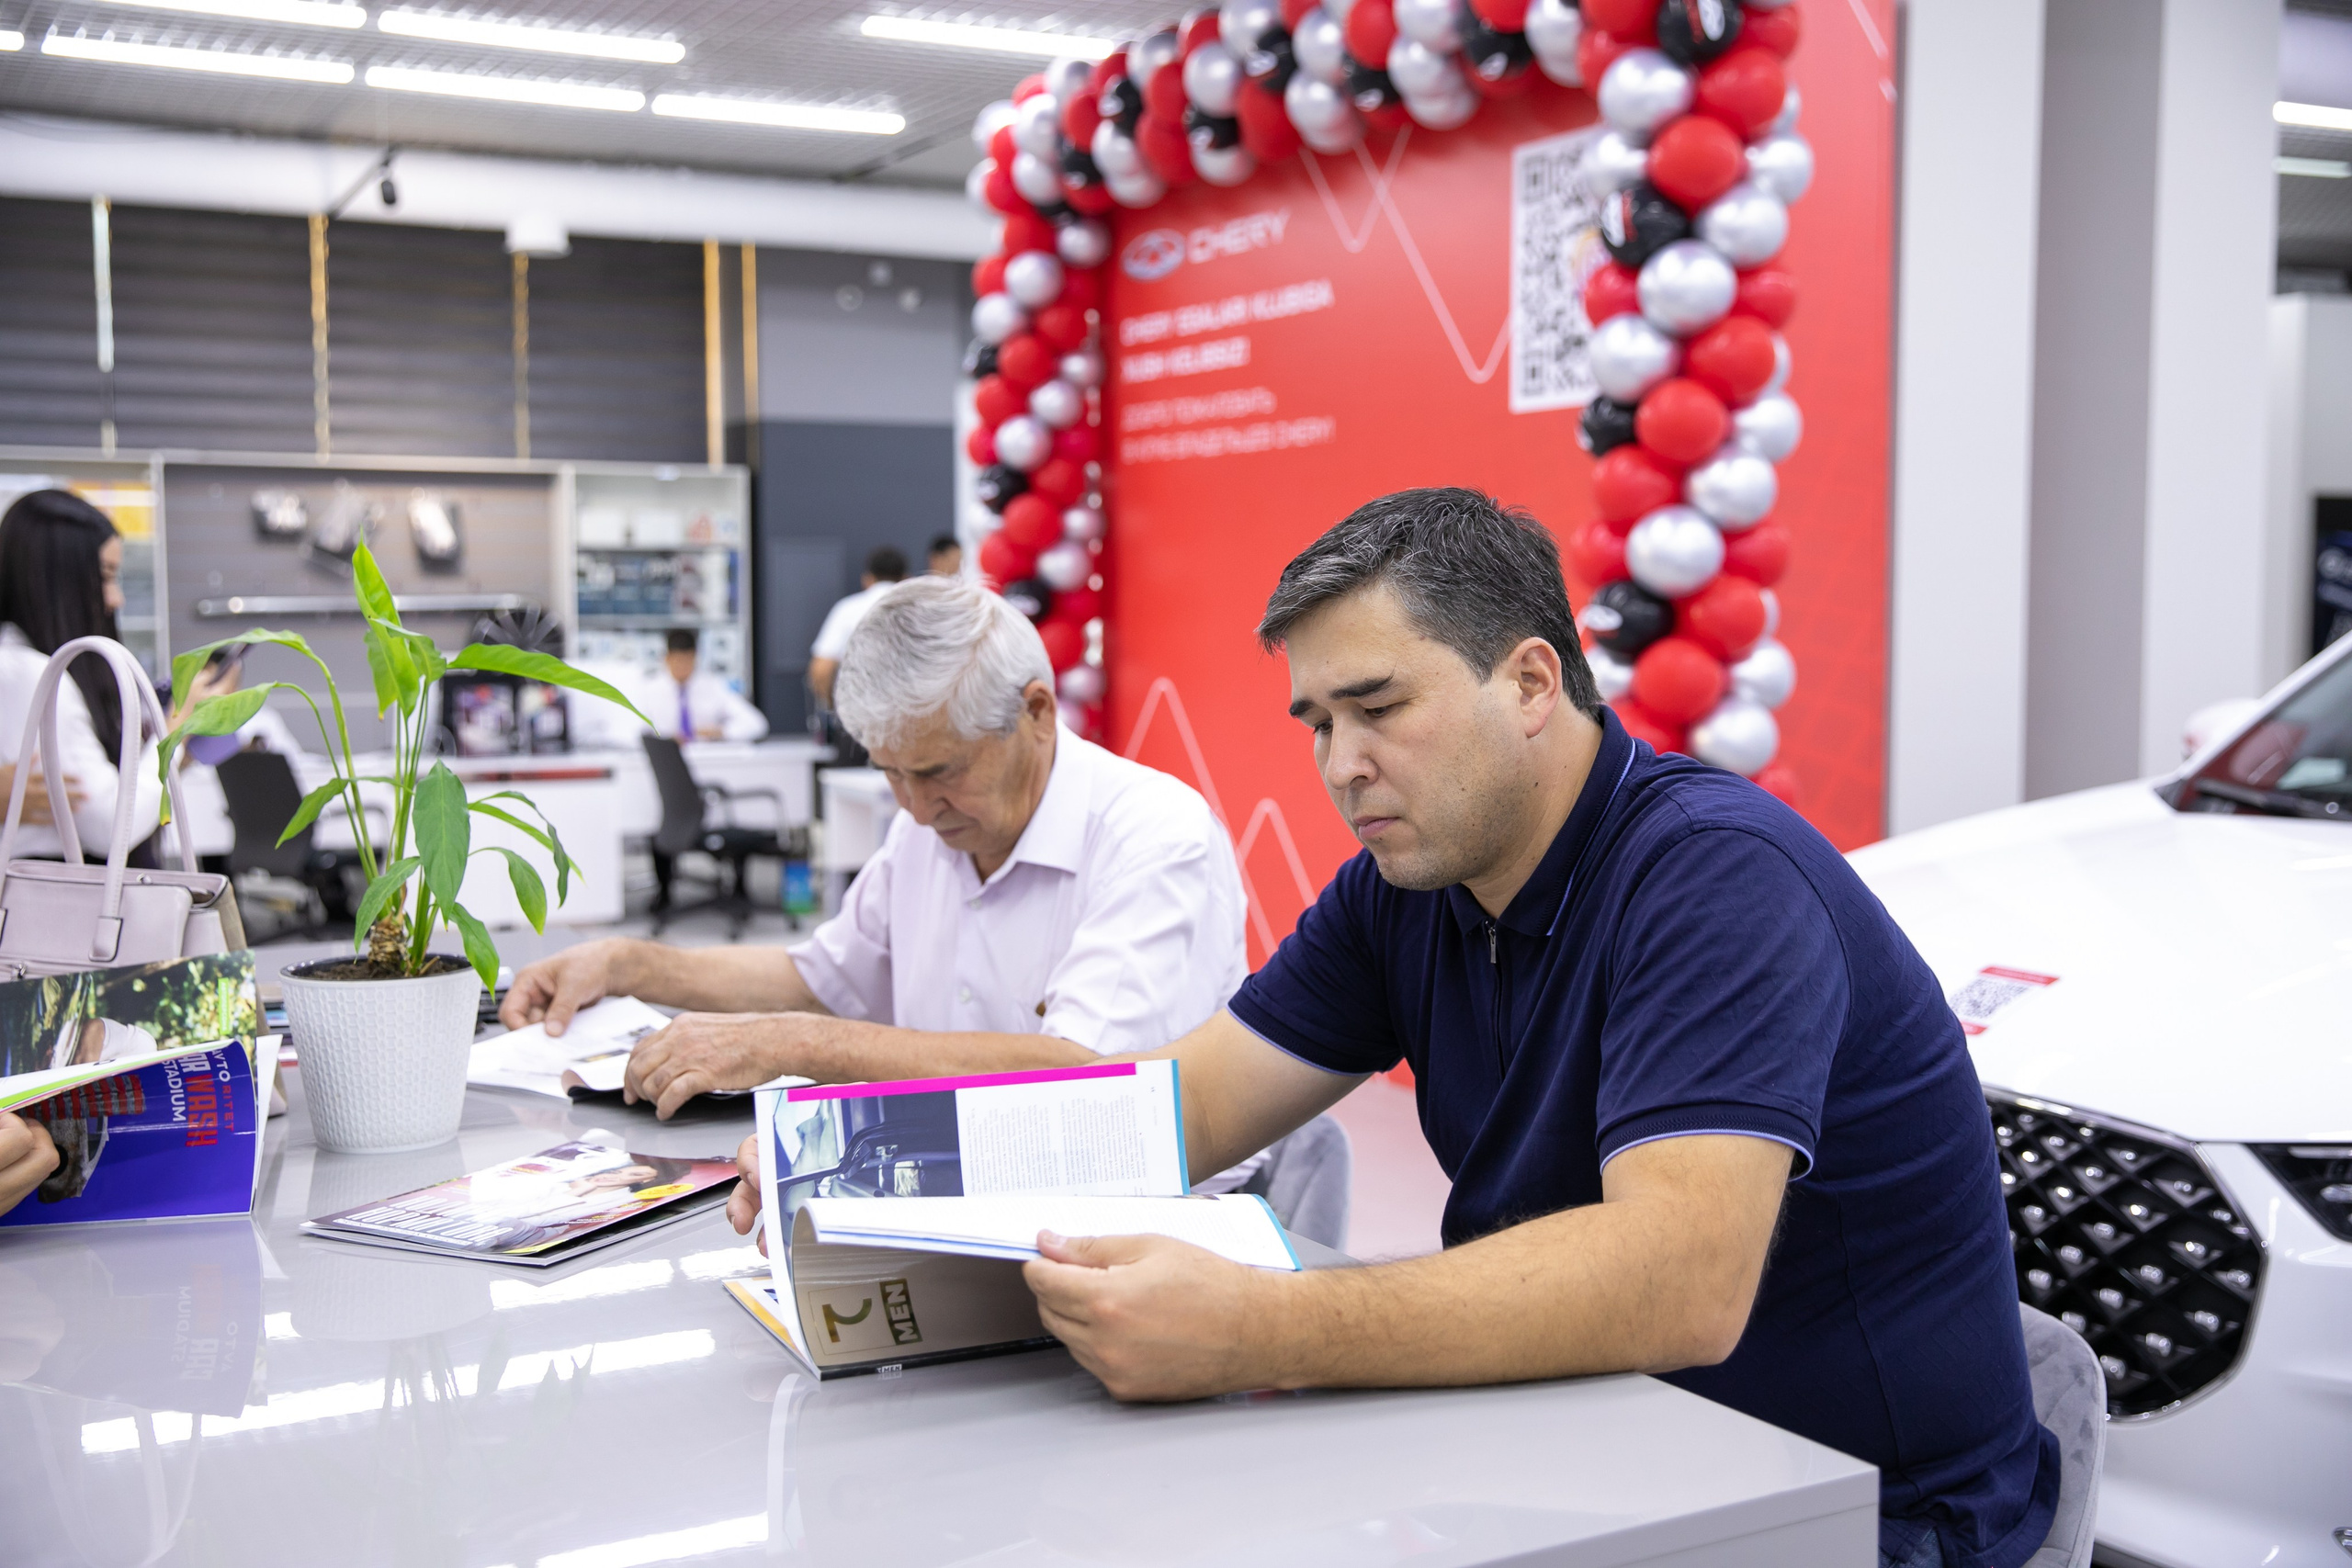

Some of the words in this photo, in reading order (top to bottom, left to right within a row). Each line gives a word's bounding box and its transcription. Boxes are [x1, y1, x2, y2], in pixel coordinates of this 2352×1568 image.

[1188, 208, 1290, 263] CHERY
[162, 1059, 187, 1122] STADIUM
[178, 1053, 211, 1073] AR
[185, 1074, 219, 1147] WASH
[885, 1282, 919, 1342] MEN
[883, 1365, 901, 1373] MEN
